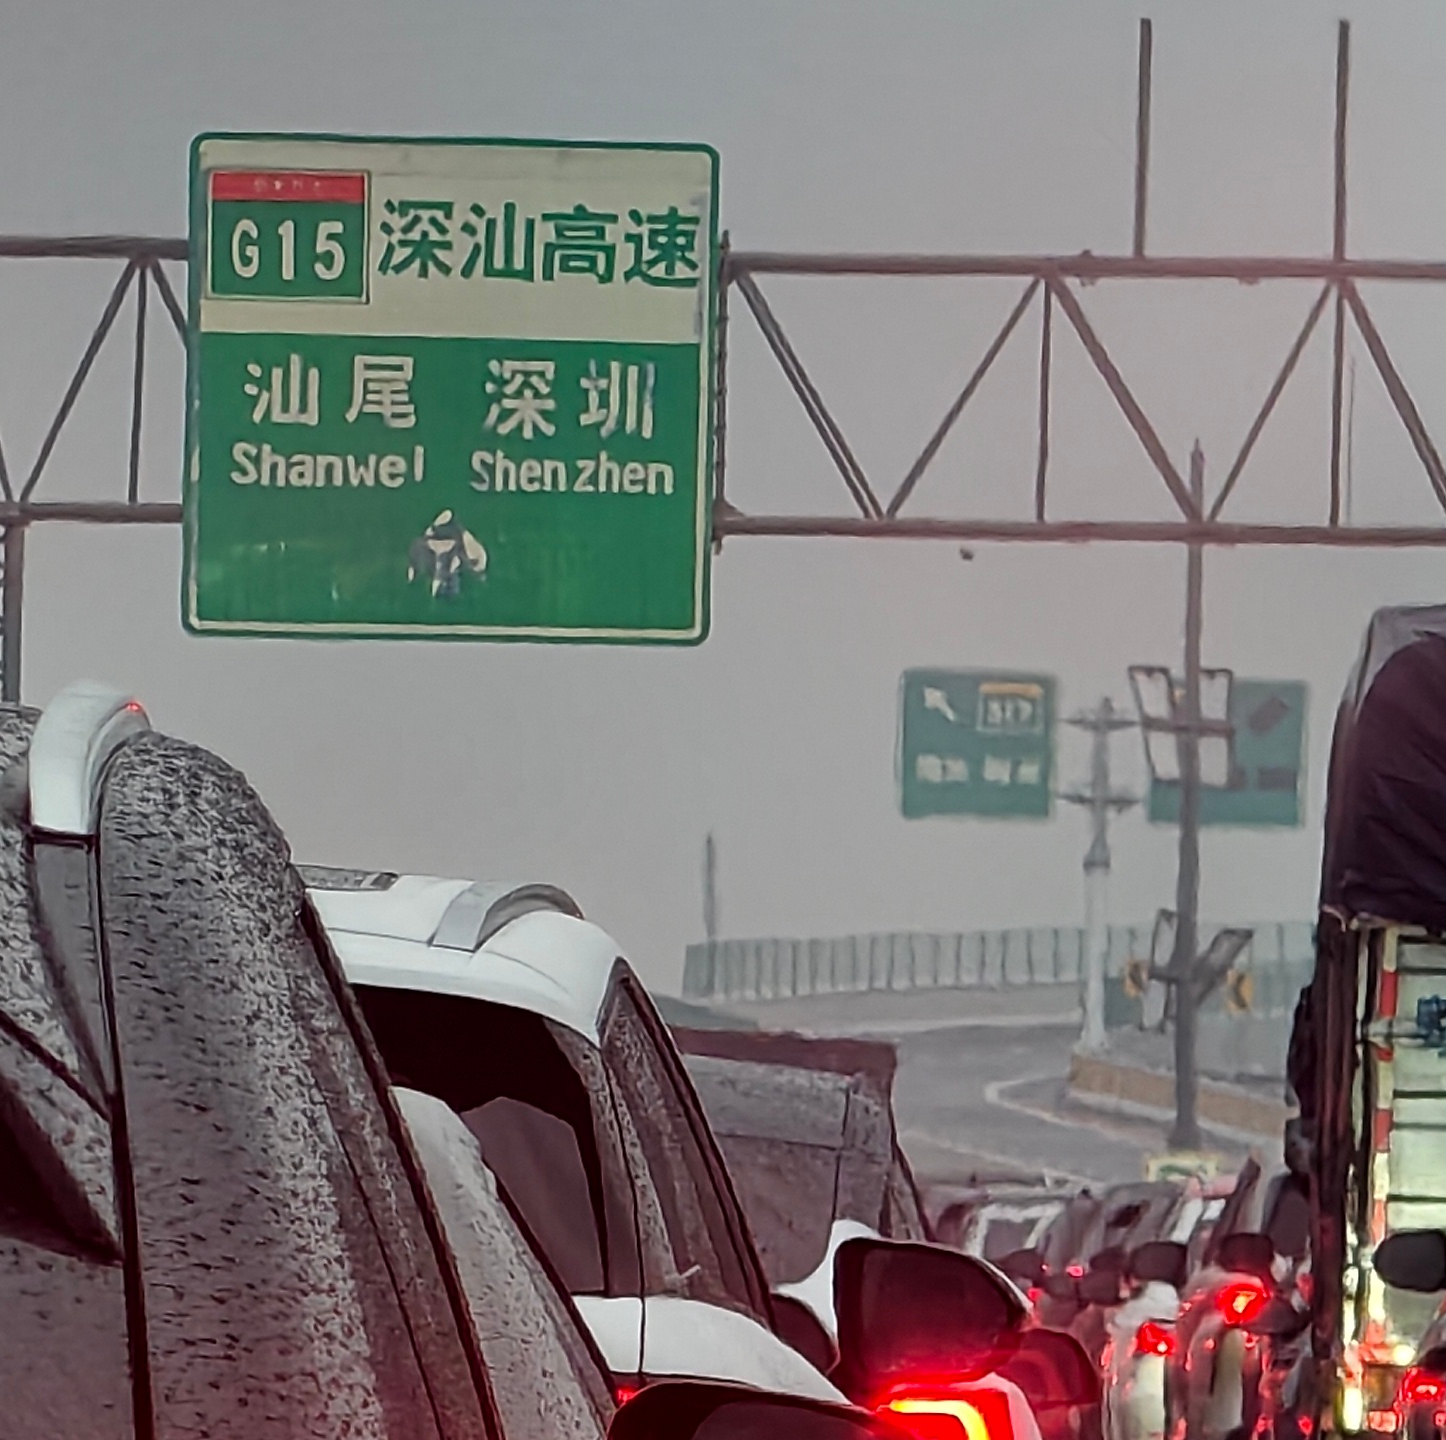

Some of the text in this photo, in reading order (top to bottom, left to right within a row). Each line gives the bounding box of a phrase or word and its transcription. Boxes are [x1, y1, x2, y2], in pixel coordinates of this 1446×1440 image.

[232, 218, 346, 281] G15
[377, 198, 702, 289] 深汕高速
[243, 353, 655, 440] 汕尾 深圳
[470, 450, 675, 495] Shenzhen
